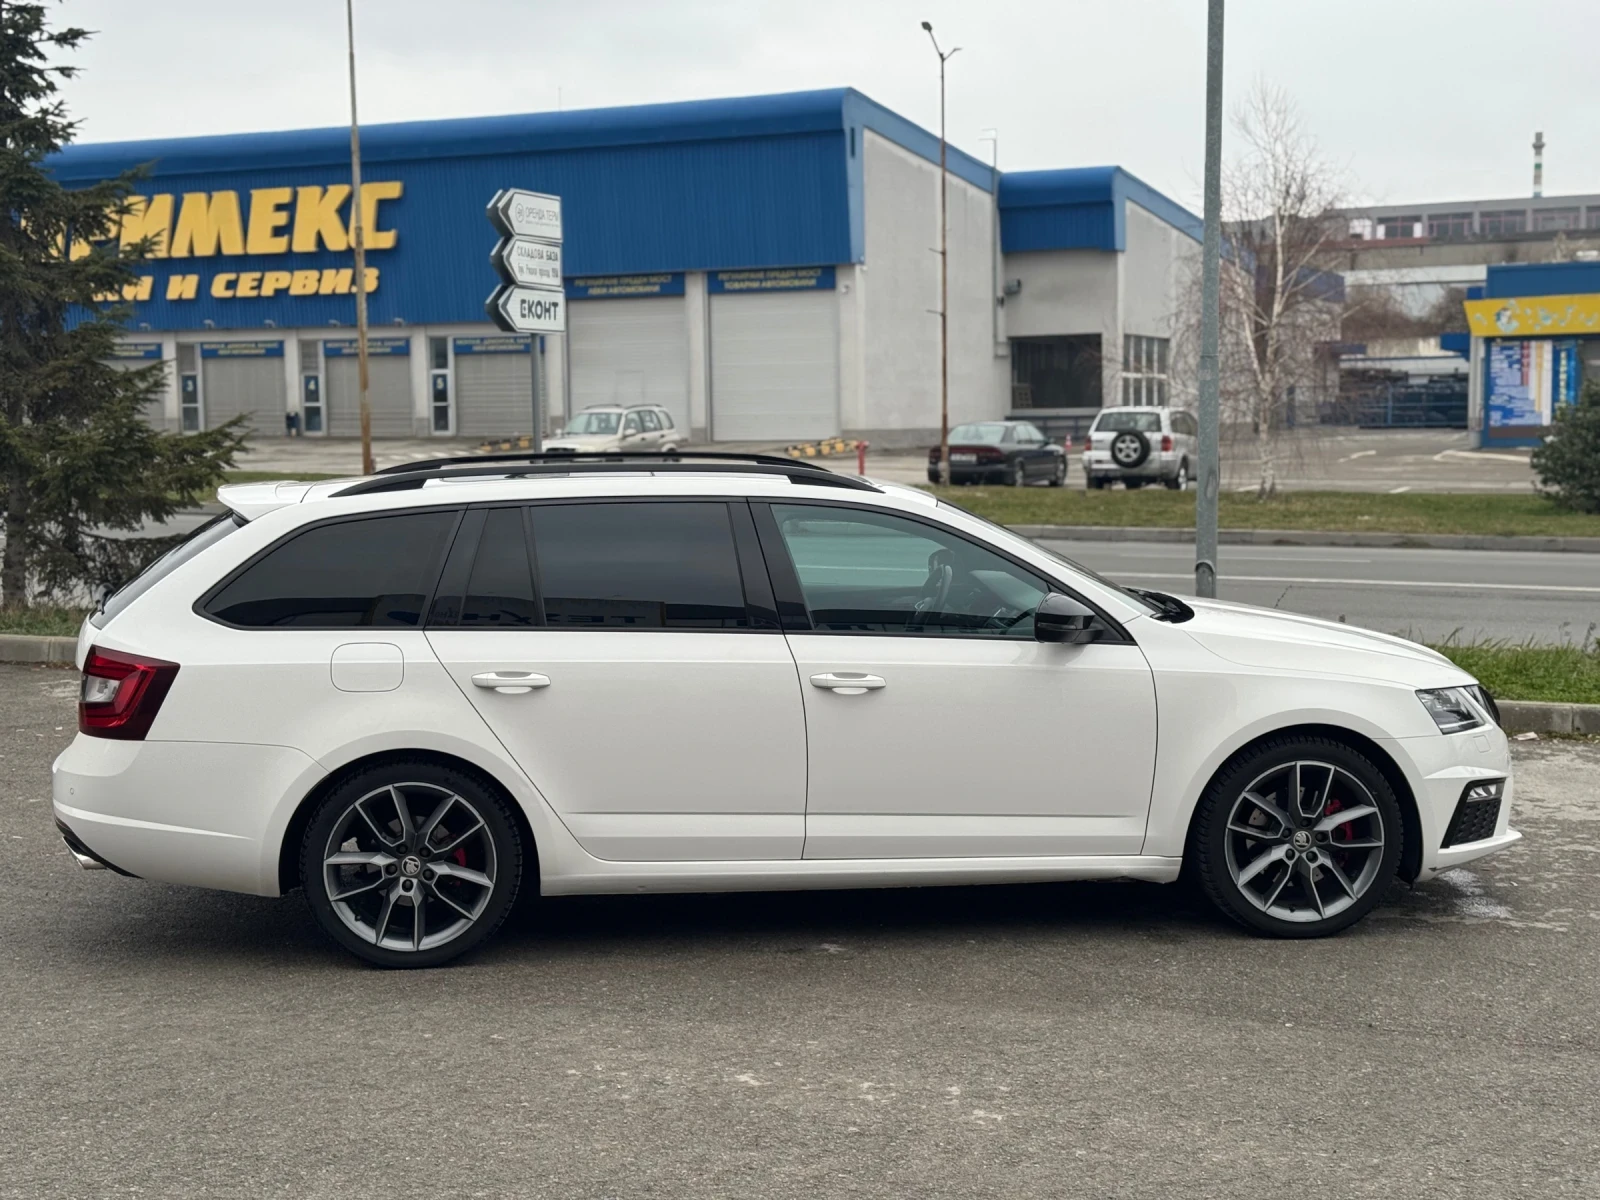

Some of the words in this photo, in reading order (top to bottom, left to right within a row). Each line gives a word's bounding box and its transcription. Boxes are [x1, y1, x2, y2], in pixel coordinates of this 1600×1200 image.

[517, 246, 544, 260] СКЛАДОВА
[546, 250, 559, 262] БАЗА
[166, 274, 199, 300] И
[520, 299, 559, 321] ЕКОНТ
[307, 379, 317, 391] 4
[436, 377, 445, 390] 5
